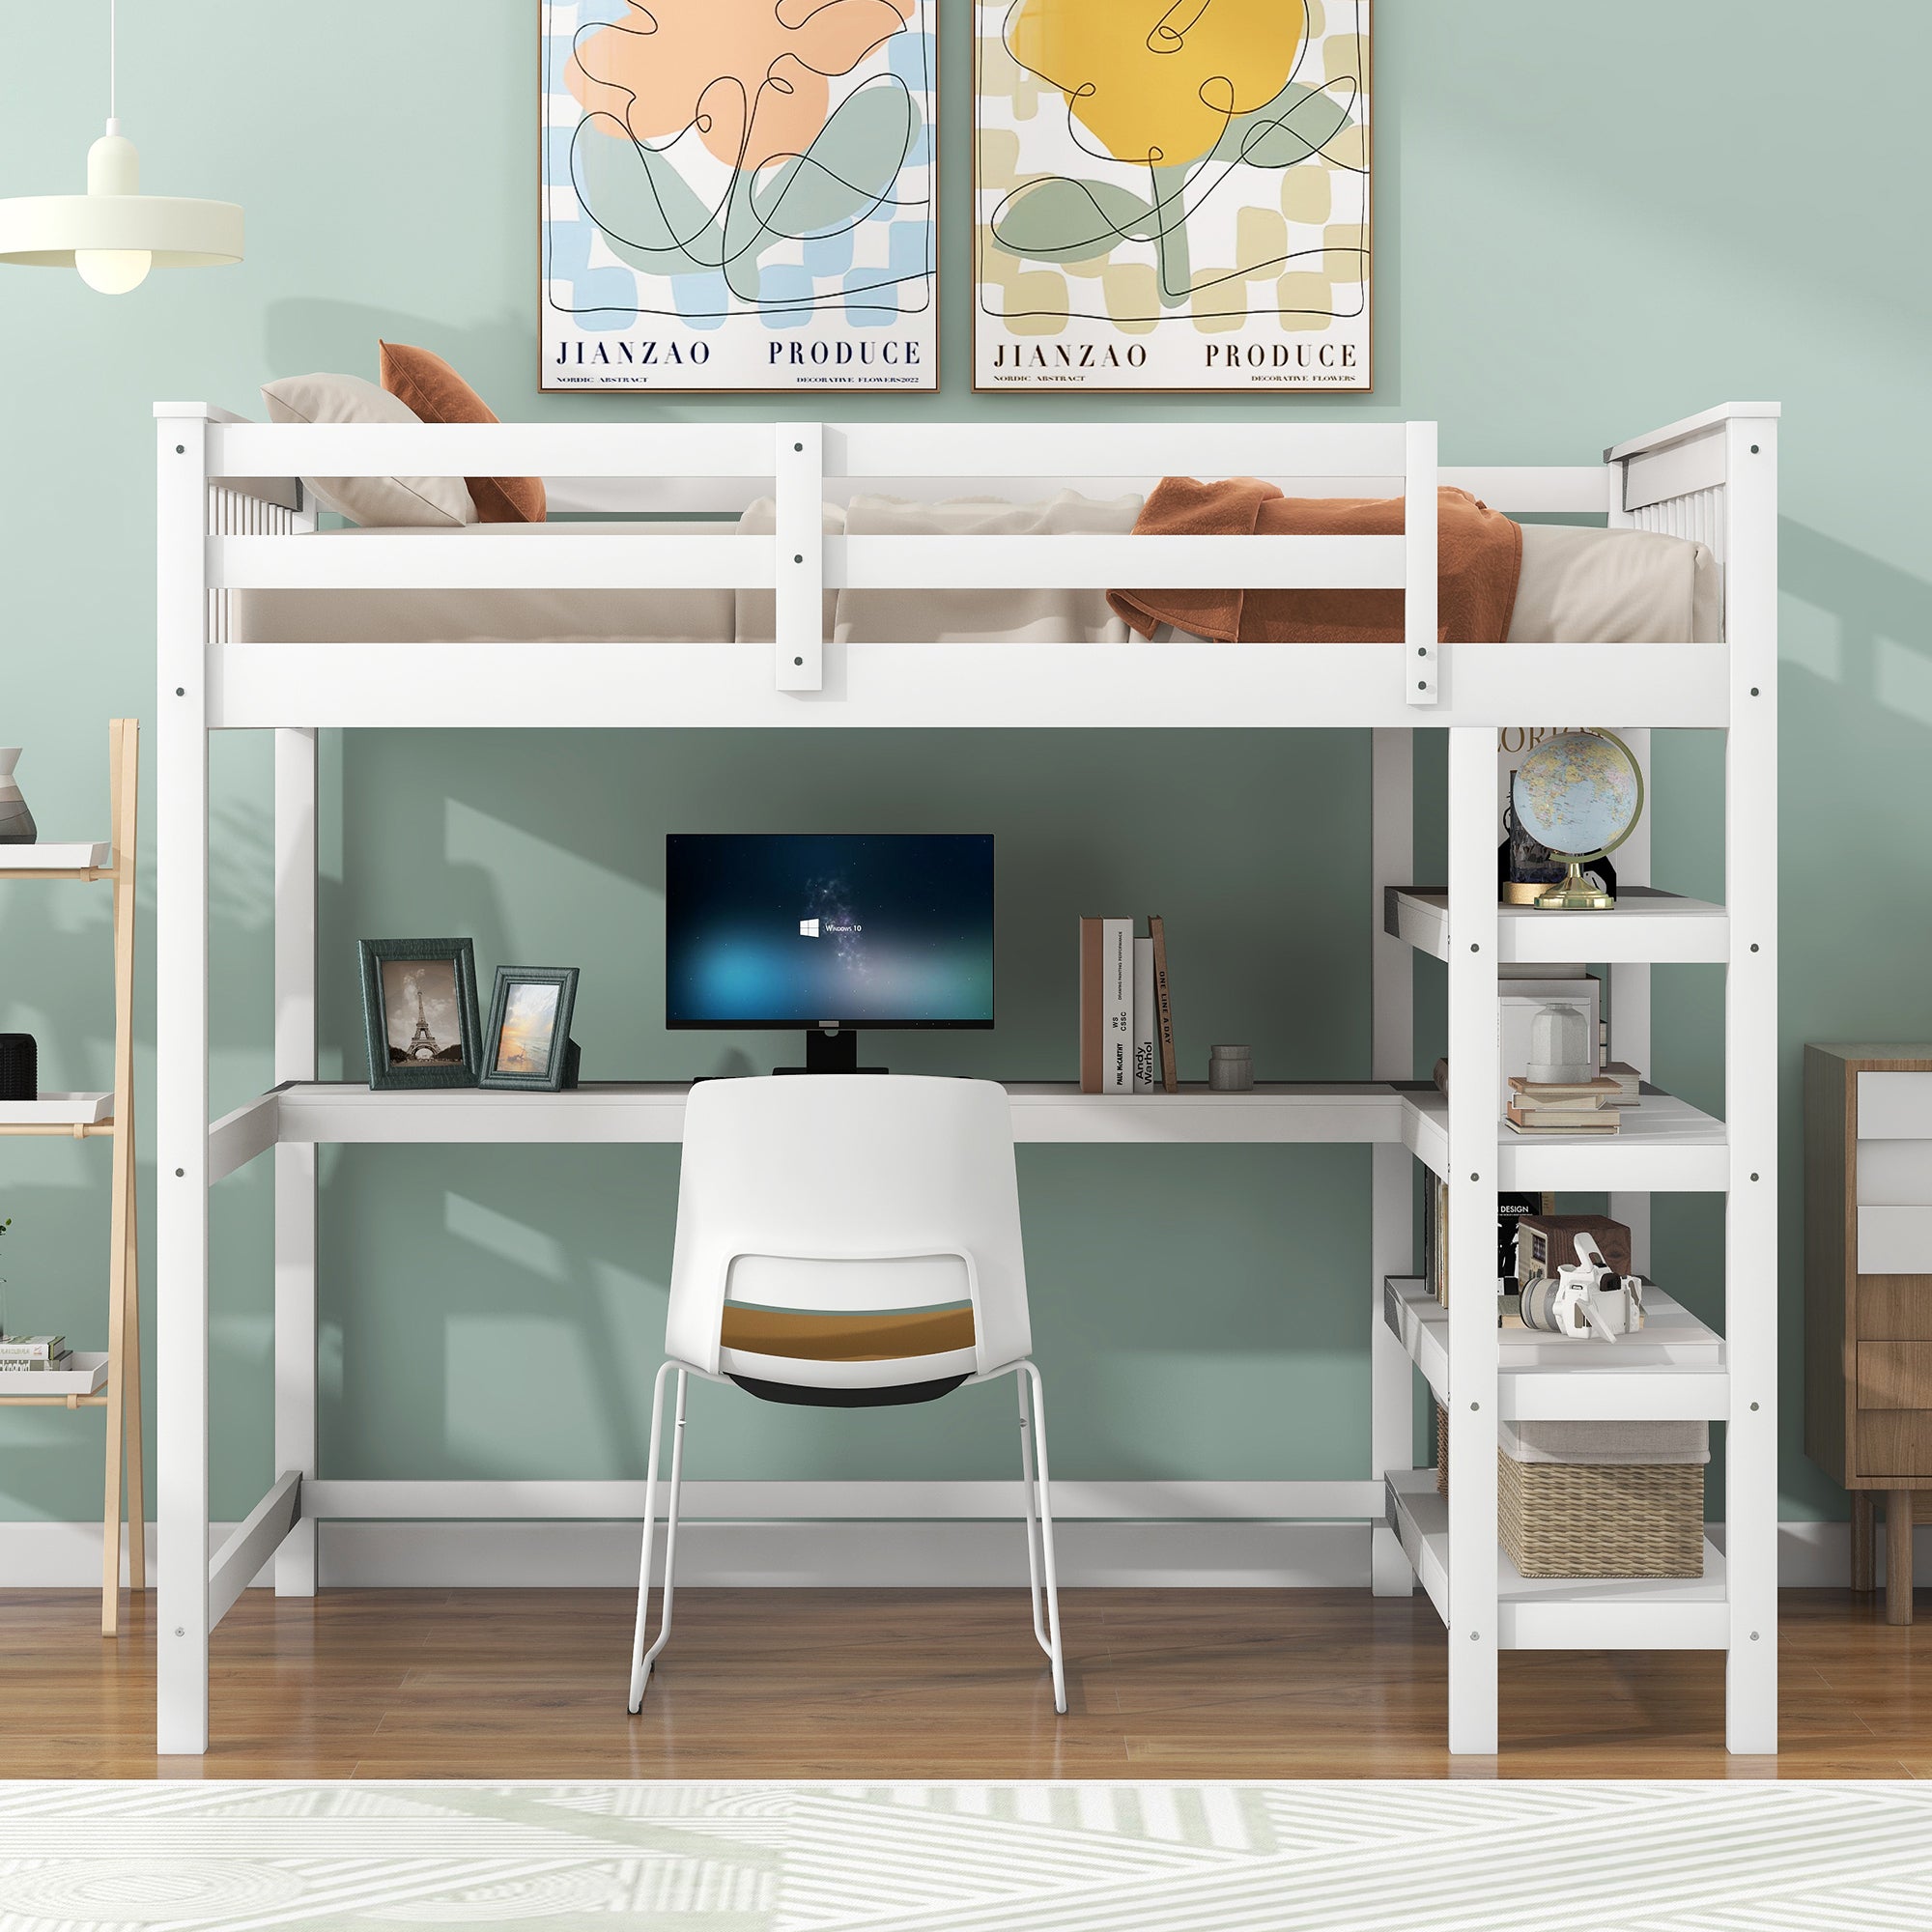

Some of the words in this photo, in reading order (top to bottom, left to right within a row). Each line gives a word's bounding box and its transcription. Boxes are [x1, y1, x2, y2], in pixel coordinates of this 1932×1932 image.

[555, 341, 710, 365] JIANZAO
[768, 341, 921, 365] PRODUCE
[993, 344, 1147, 368] JIANZAO
[1206, 344, 1356, 368] PRODUCE
[1113, 1017, 1119, 1029] WS
[1135, 1047, 1147, 1080] Andy
[1144, 1042, 1152, 1085] Warhol
